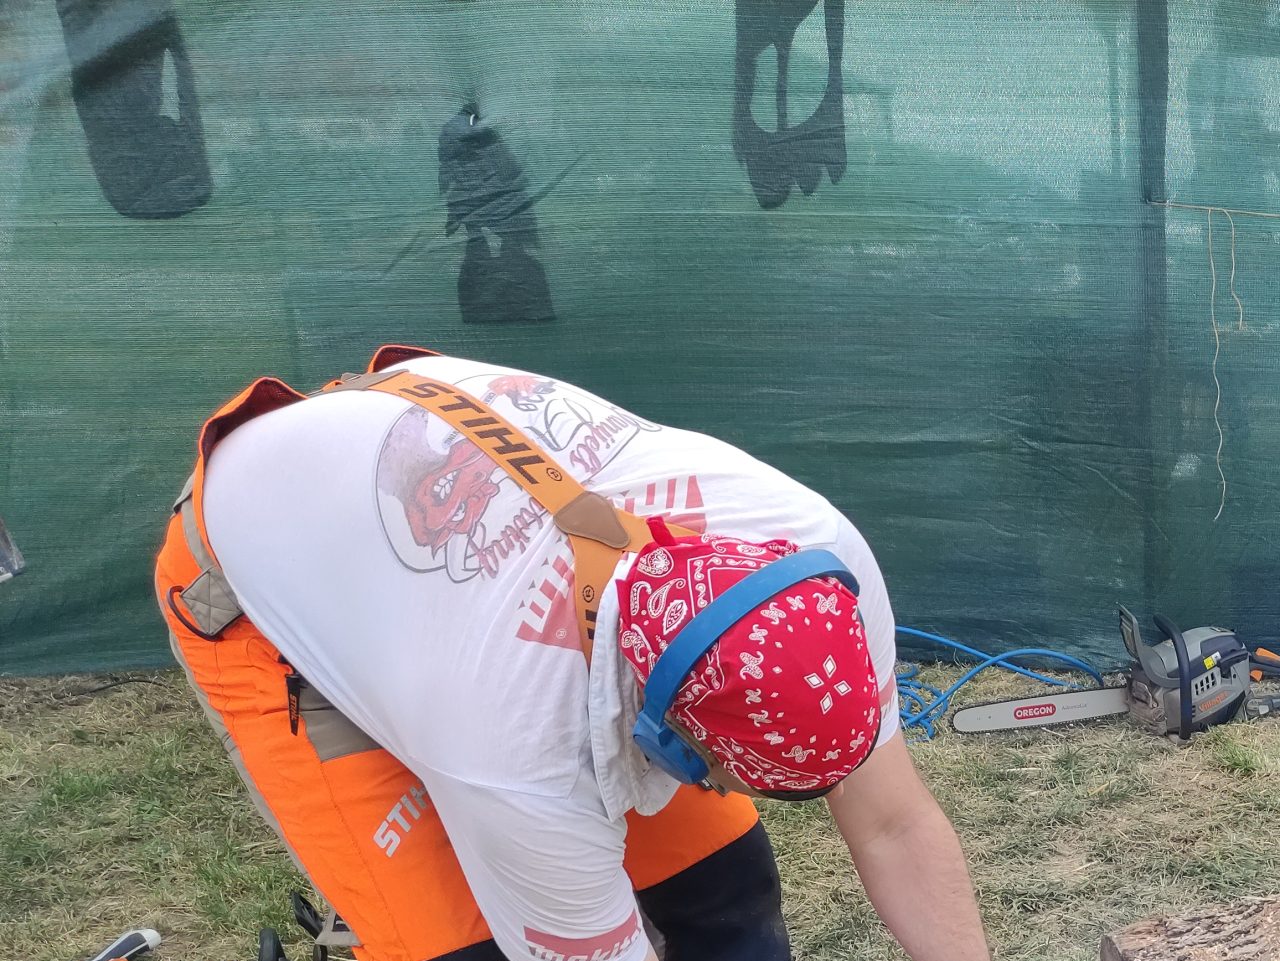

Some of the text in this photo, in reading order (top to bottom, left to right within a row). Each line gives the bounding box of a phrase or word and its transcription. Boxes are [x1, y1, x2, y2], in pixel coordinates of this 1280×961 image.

[399, 382, 546, 485] STIHL
[1015, 705, 1053, 718] OREGON
[373, 786, 427, 858] STIH
